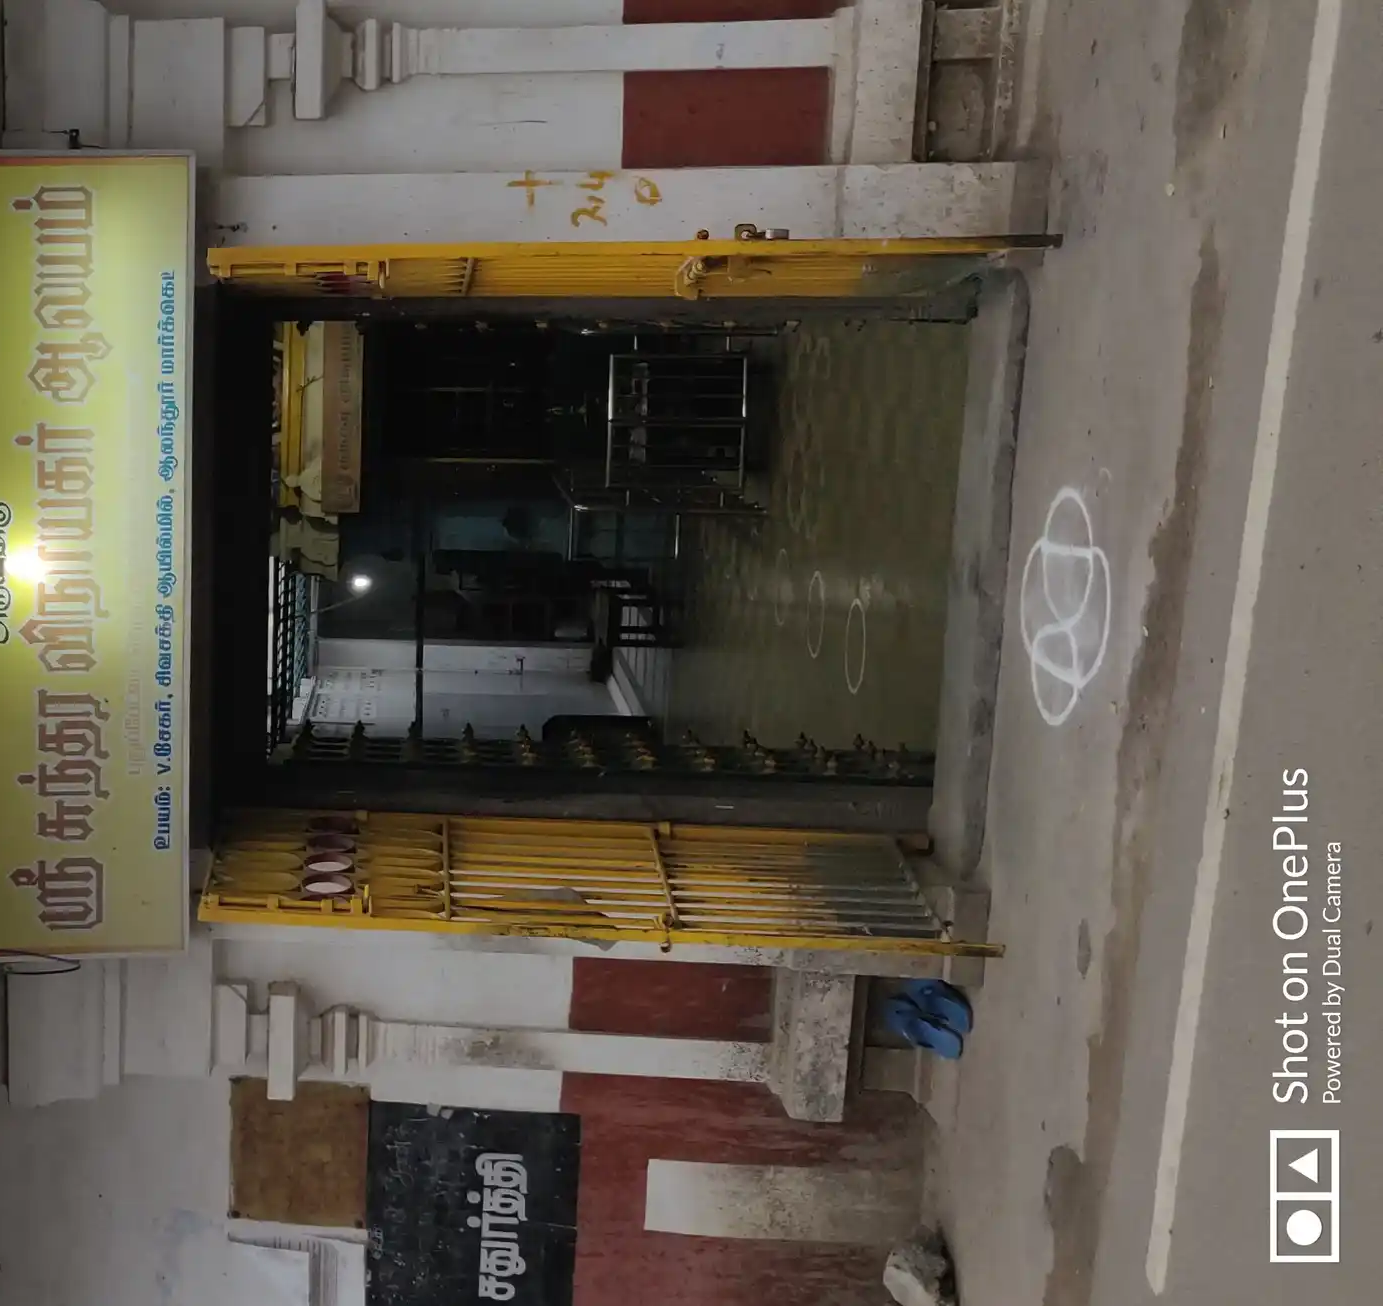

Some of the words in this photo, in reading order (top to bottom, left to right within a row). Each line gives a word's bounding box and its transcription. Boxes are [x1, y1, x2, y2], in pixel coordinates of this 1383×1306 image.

[11, 185, 113, 404] ஆலயம்
[157, 270, 176, 375] மார்க்கெட்
[156, 380, 179, 482] ஆலந்தூர்
[14, 422, 110, 673] விநாயகர்
[154, 603, 176, 687] சிவசக்தி
[17, 688, 110, 842] சுந்தர
[153, 786, 171, 851] உபயம்:
[465, 1151, 529, 1301] சதுர்த்தி
